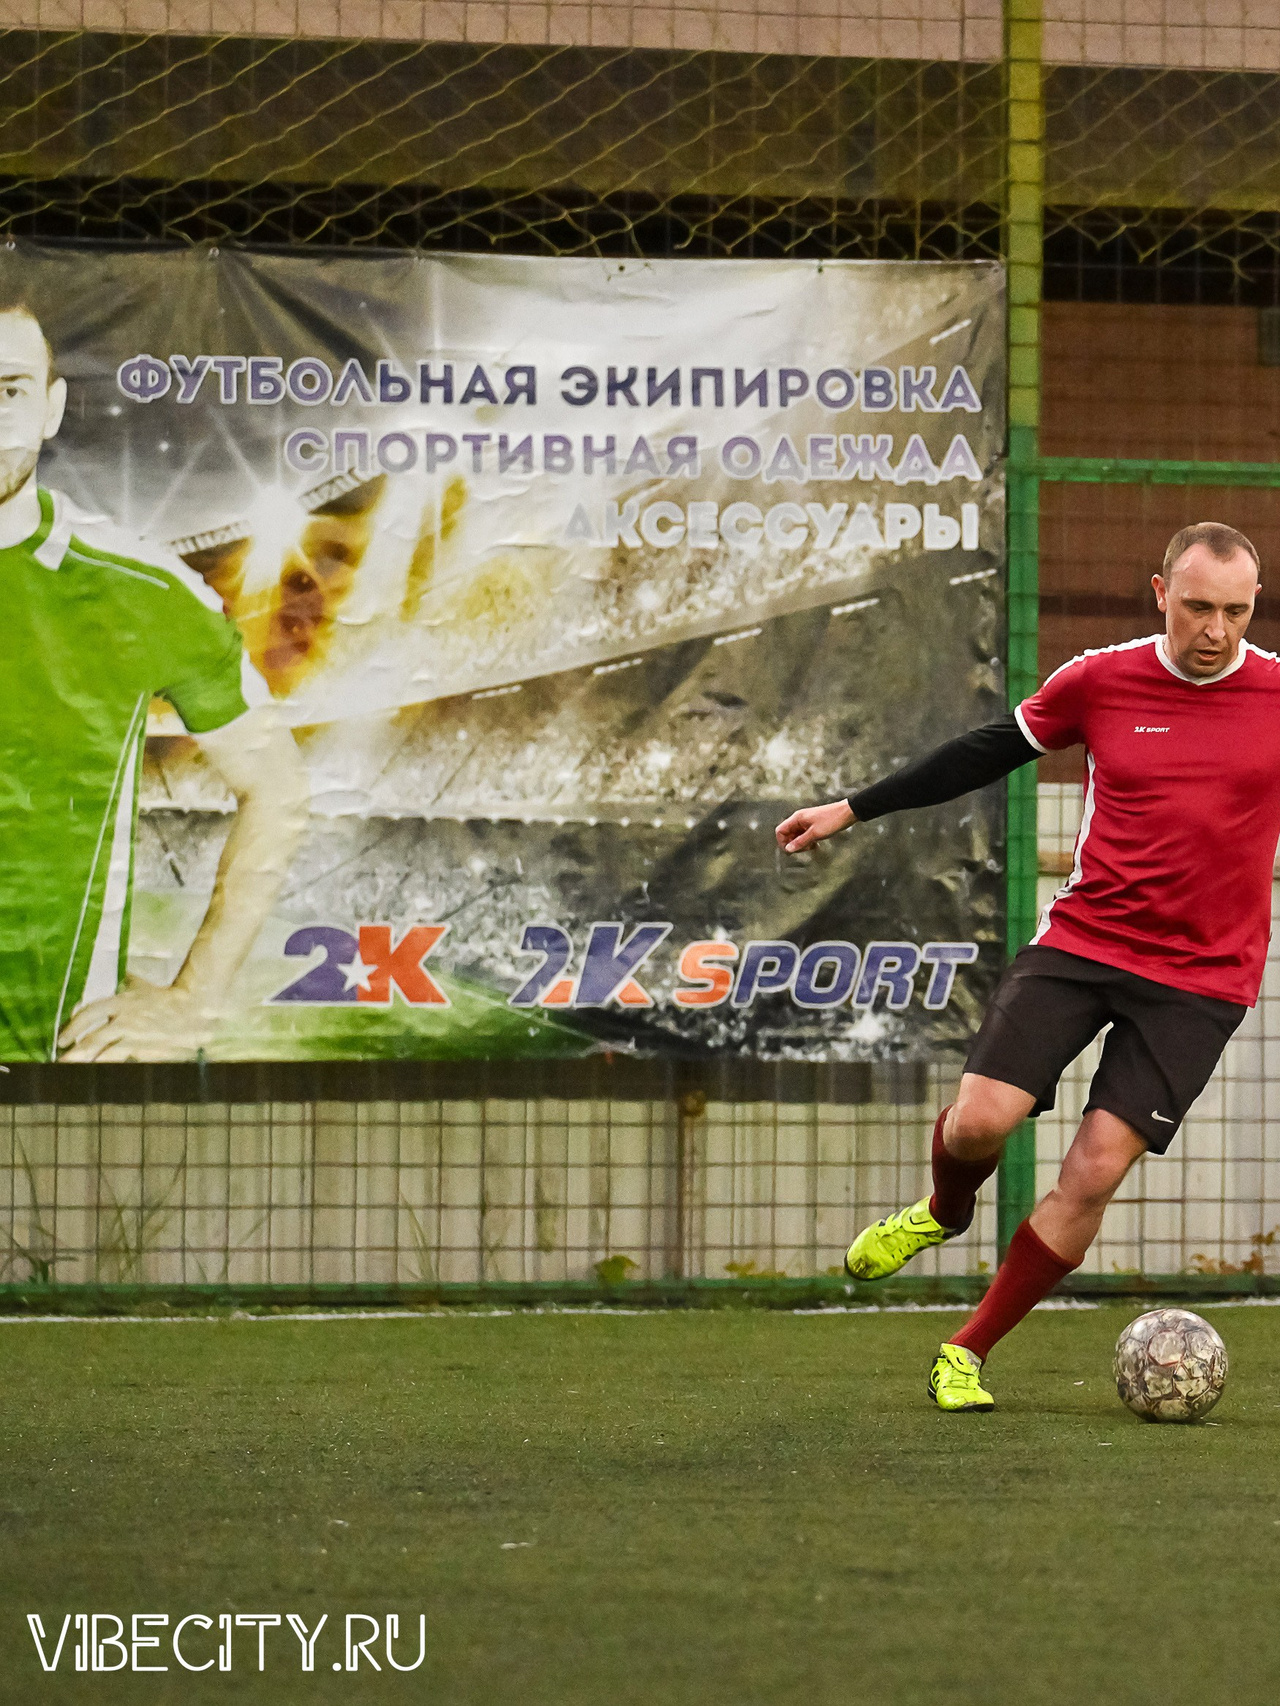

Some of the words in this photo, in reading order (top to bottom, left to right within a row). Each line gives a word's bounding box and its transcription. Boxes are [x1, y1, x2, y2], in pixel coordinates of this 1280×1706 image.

[117, 354, 537, 405] ФУТБОЛЬНАЯ
[560, 365, 982, 412] ЭКИПИРОВКА
[284, 426, 700, 479] СПОРТИВНАЯ
[720, 433, 982, 485] ОДЕЖДА
[563, 500, 981, 551] АКСЕССУАРЫ
[267, 924, 451, 1008] 2K
[509, 921, 674, 1009] 2K
[674, 940, 980, 1010] SPORT
